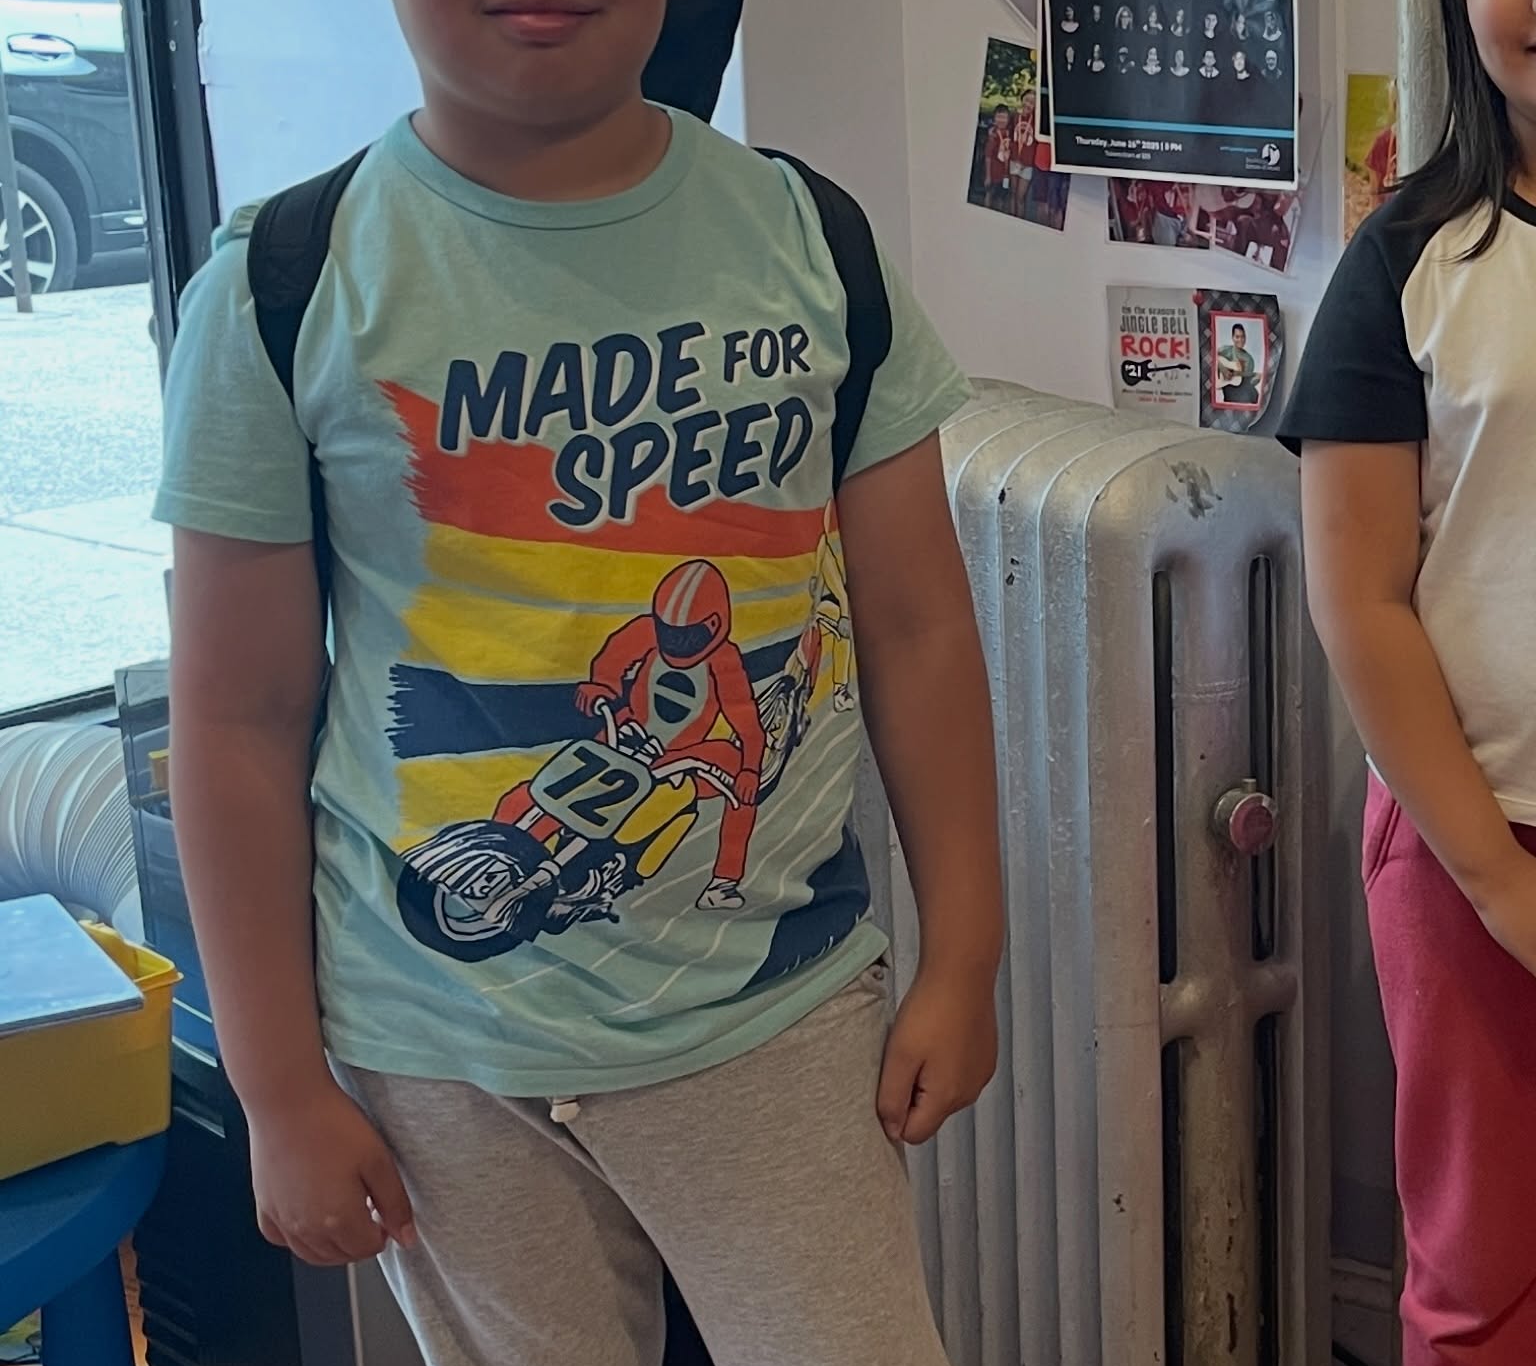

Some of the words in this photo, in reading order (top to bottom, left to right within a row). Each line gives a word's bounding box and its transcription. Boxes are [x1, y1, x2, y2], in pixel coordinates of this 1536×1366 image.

[440, 321, 708, 452] MADE
[721, 323, 812, 384] FOR
[1121, 334, 1190, 361] ROCK!
[547, 396, 815, 528] SPEED
[543, 746, 640, 827] 72
